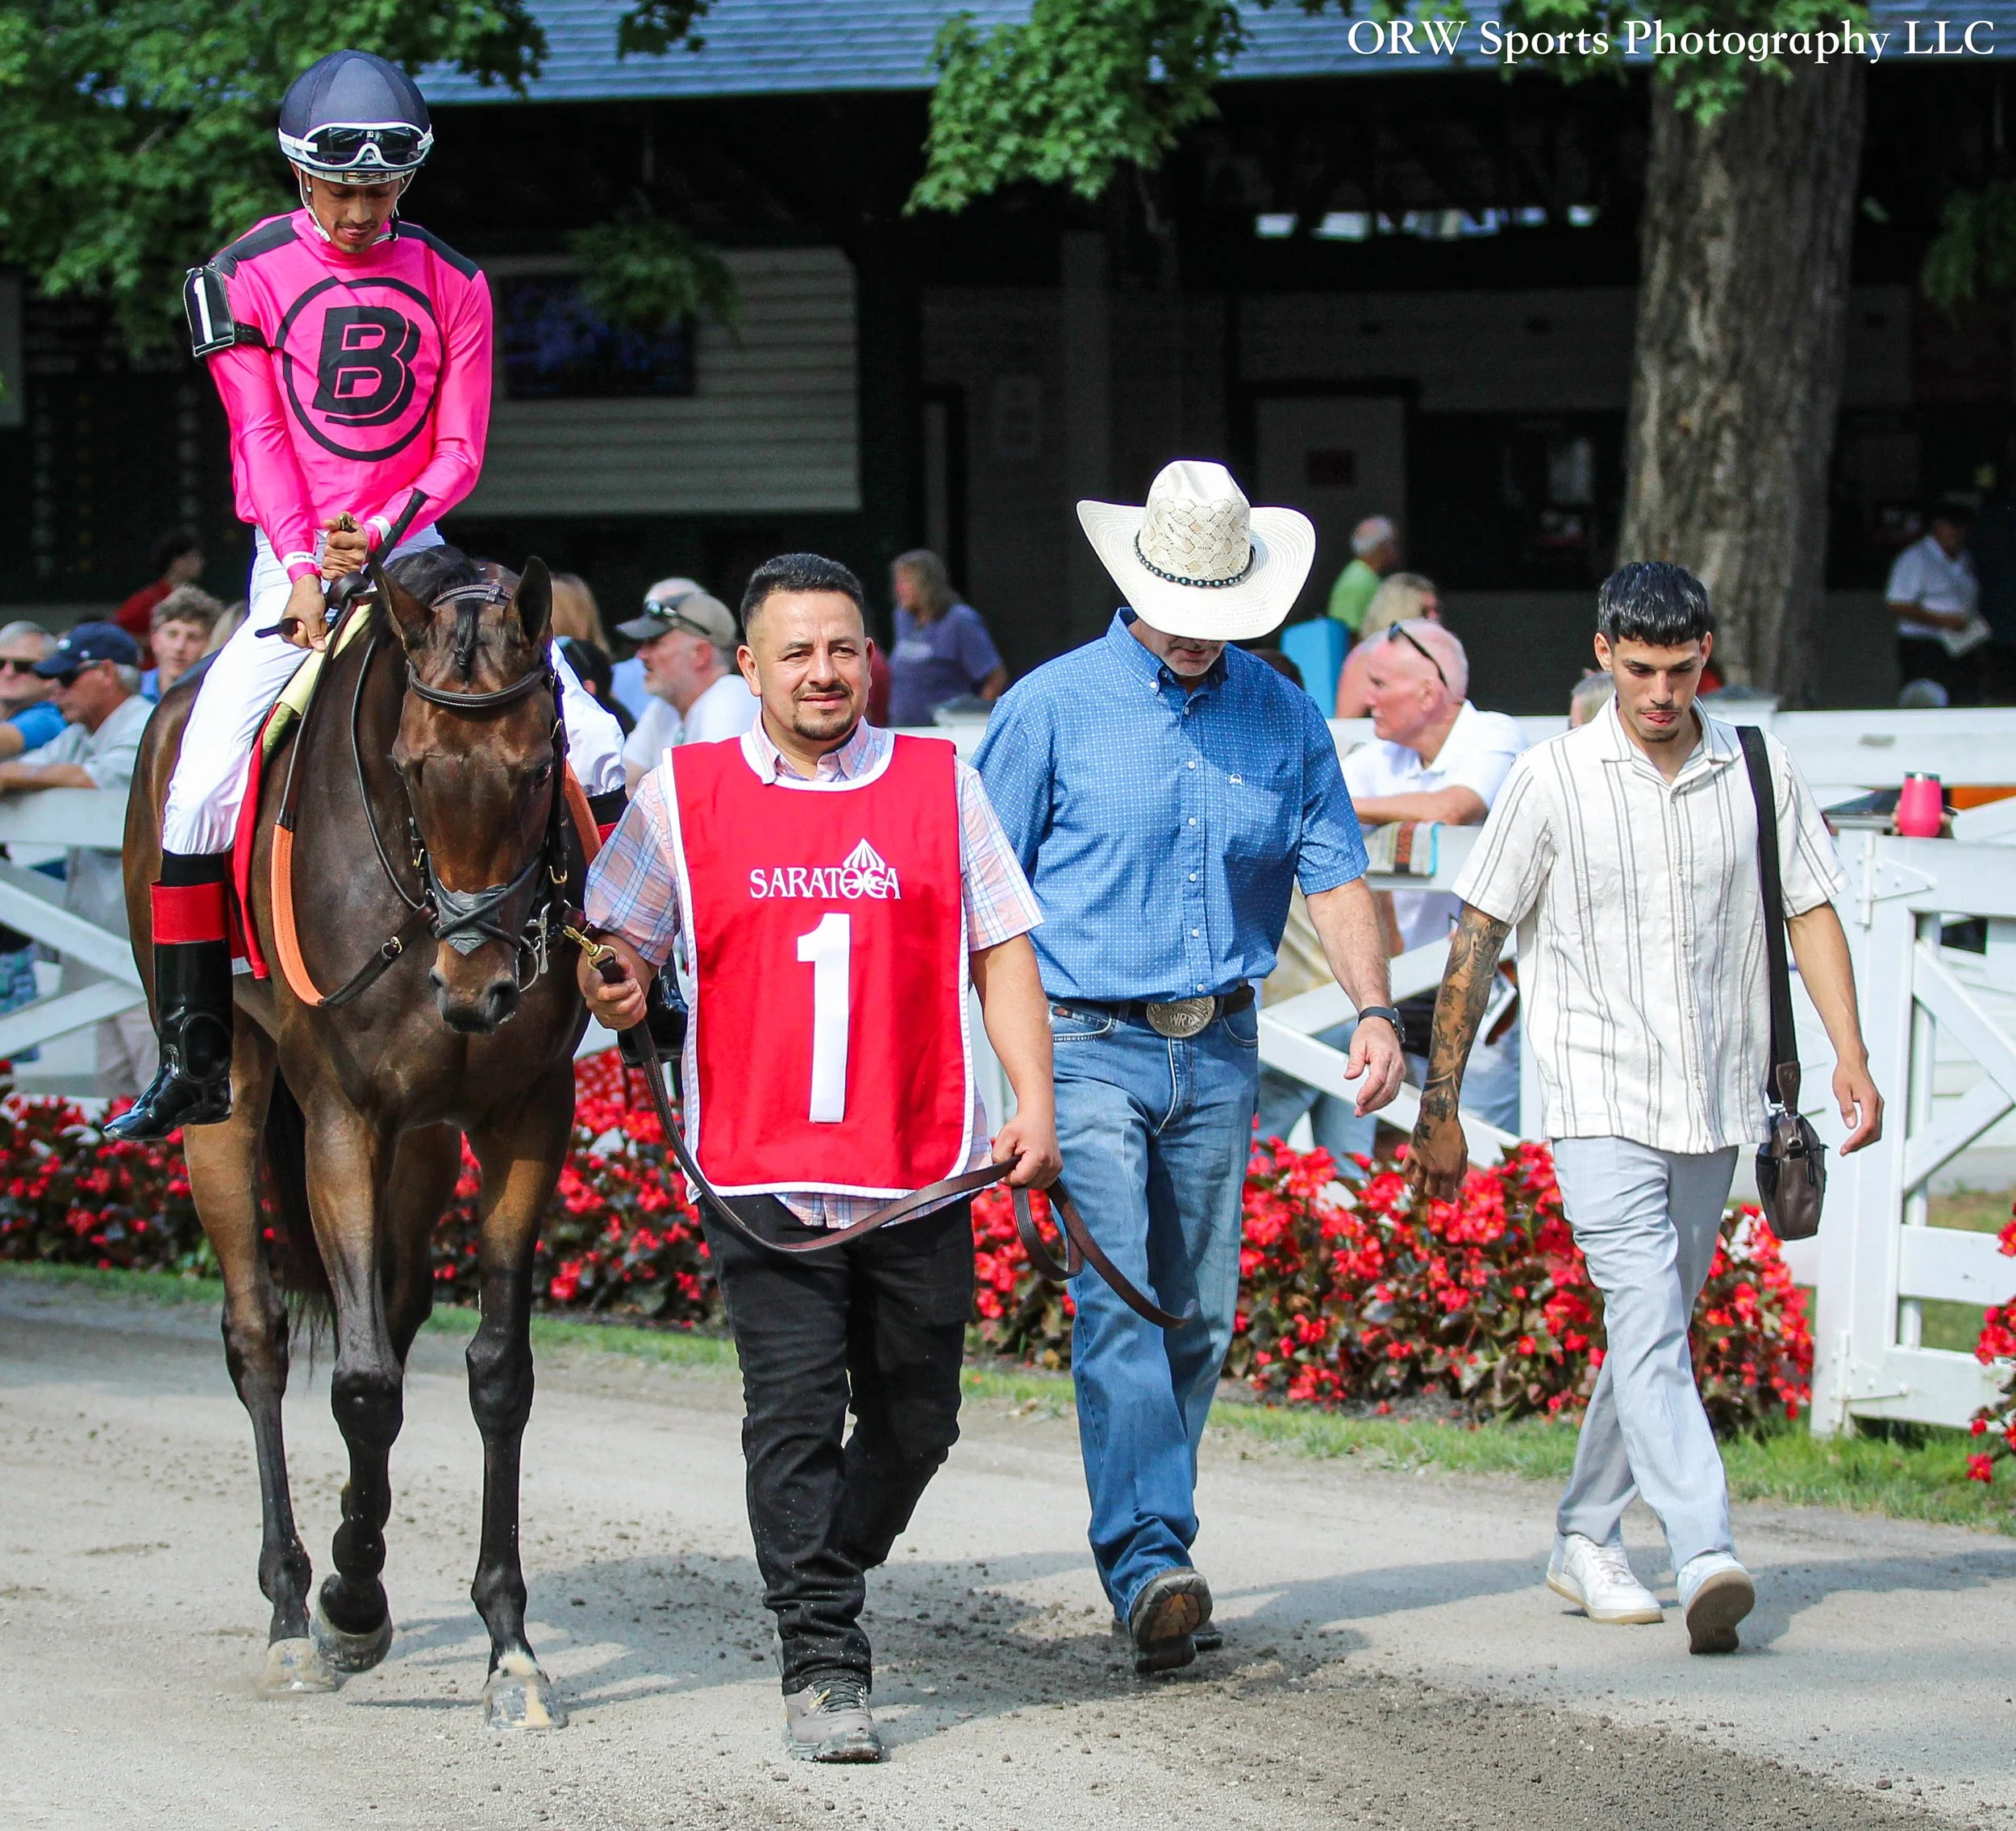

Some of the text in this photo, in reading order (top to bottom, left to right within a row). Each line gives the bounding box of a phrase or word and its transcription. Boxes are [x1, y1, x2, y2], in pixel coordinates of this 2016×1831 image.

[194, 276, 215, 344] 1
[312, 305, 421, 427] B
[750, 867, 902, 900] SARATOGA
[797, 913, 850, 1123] 1
